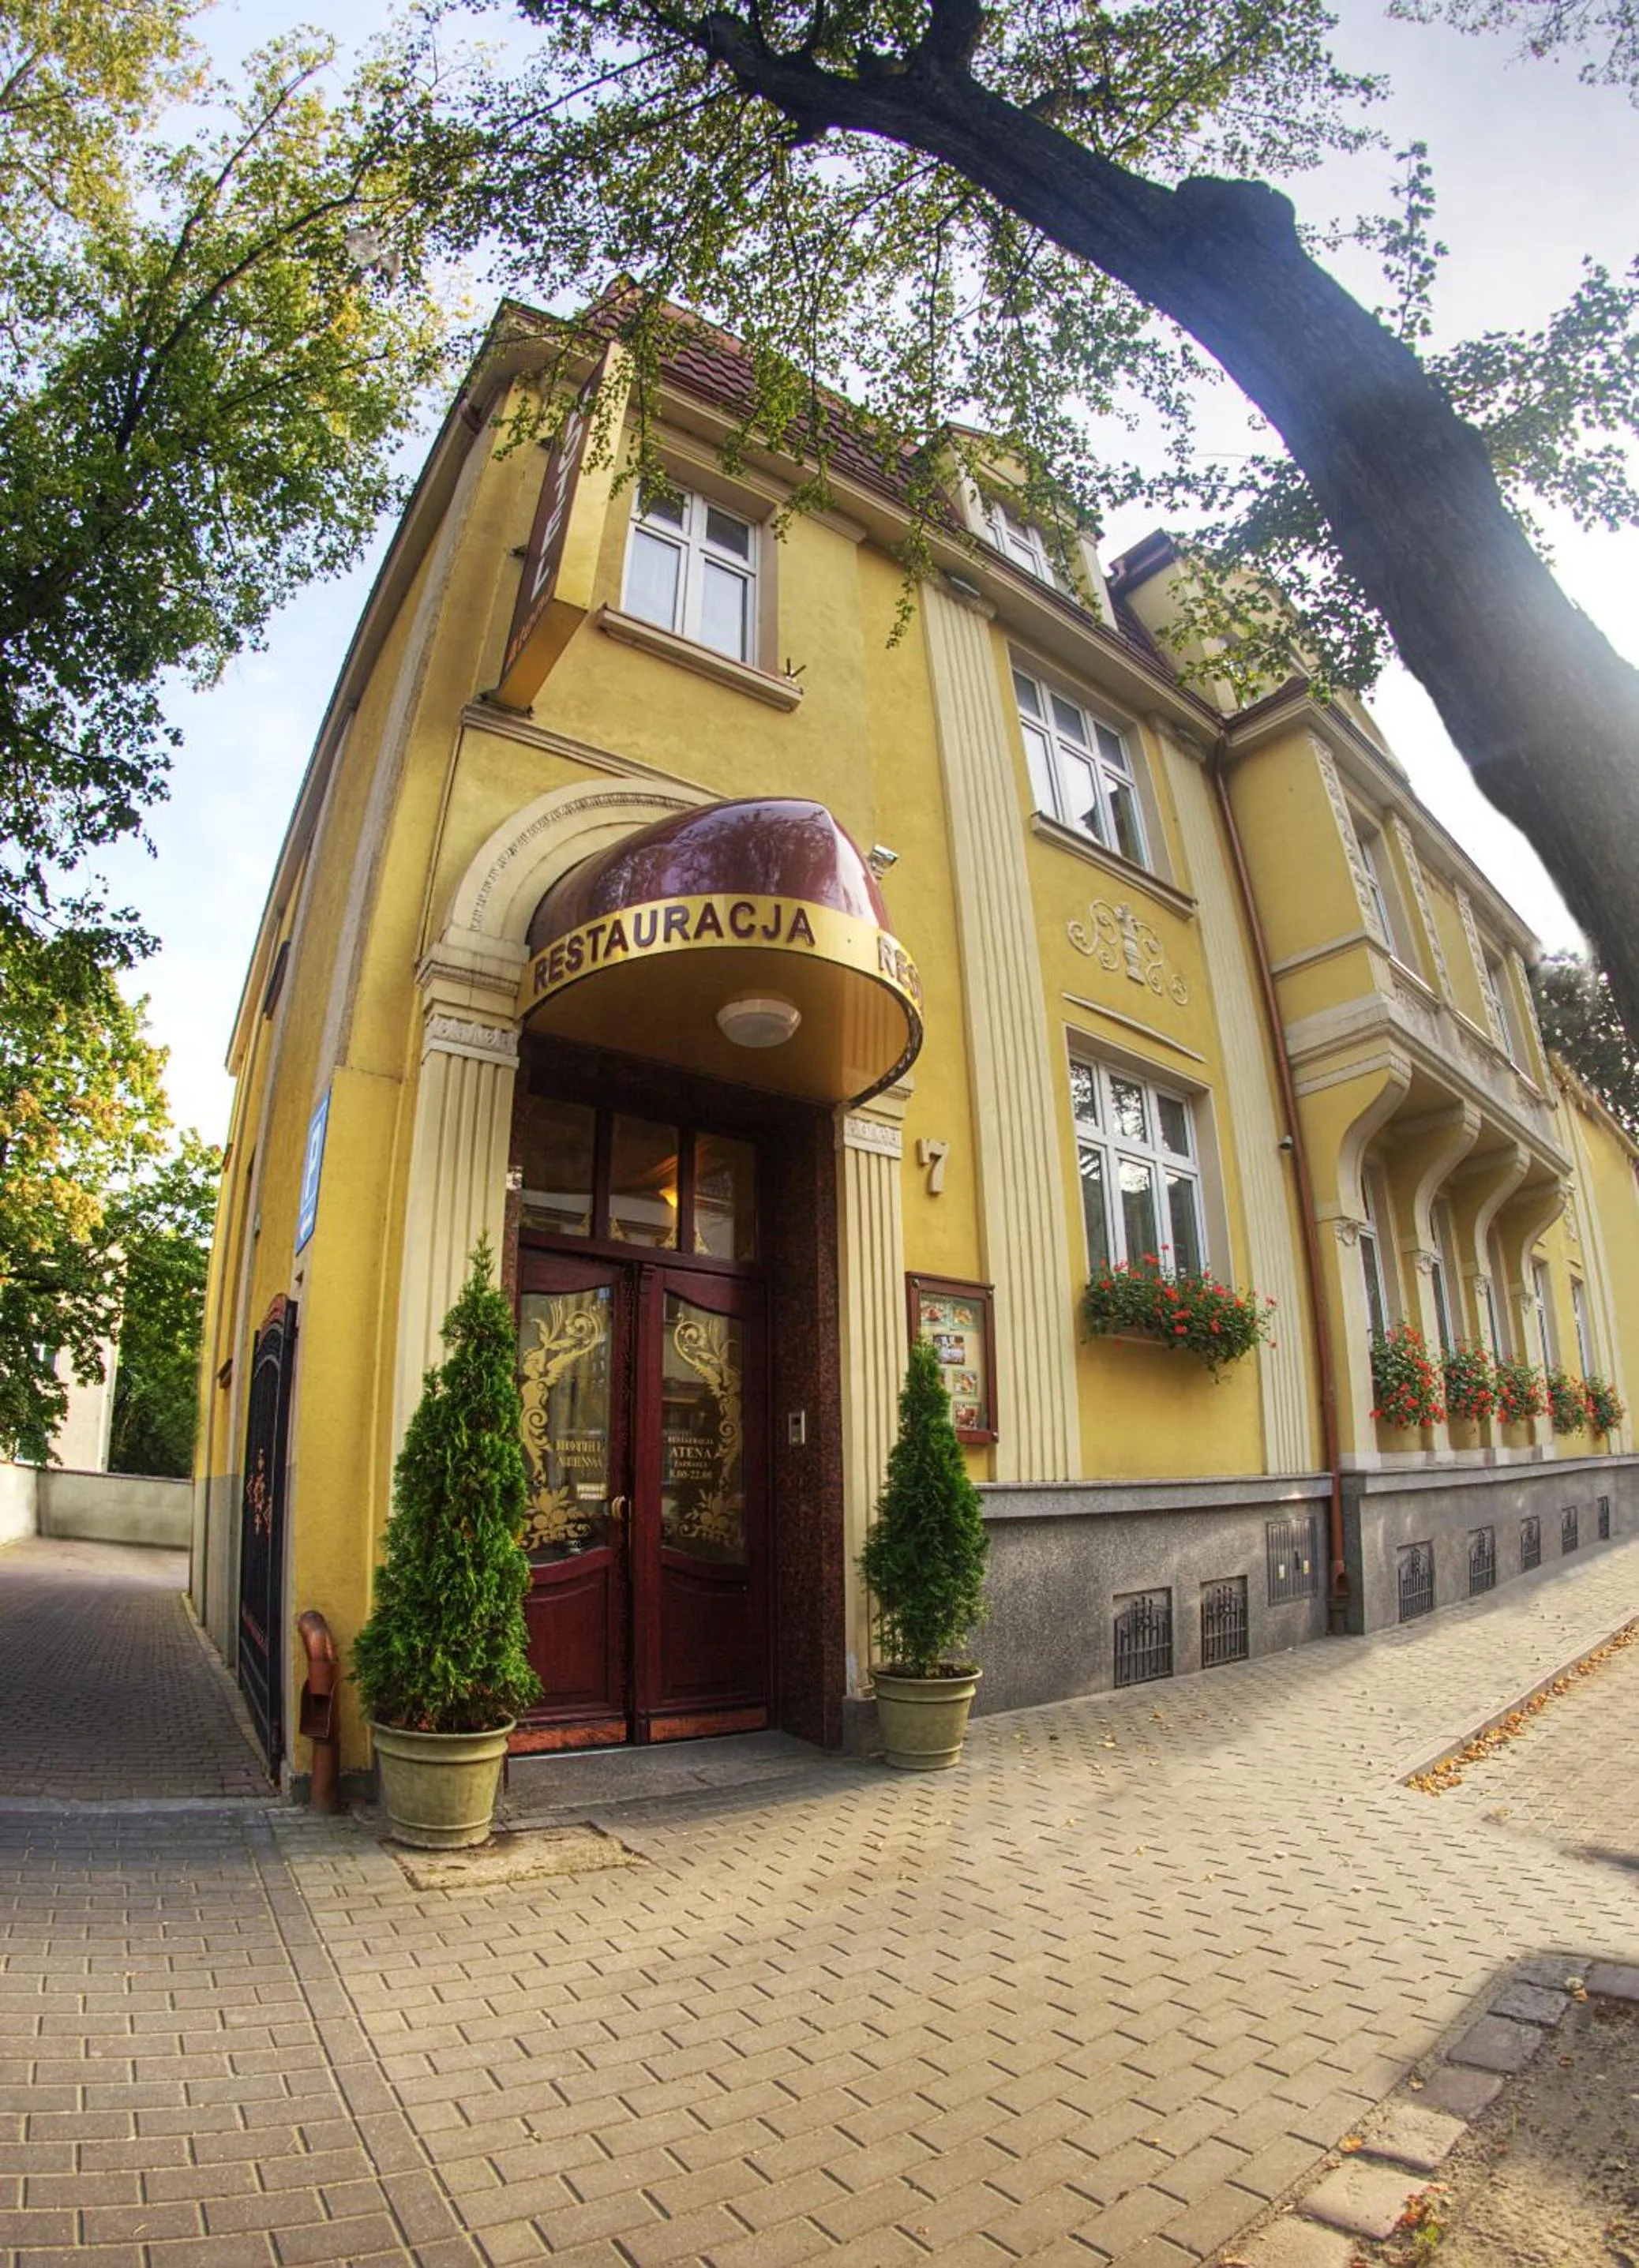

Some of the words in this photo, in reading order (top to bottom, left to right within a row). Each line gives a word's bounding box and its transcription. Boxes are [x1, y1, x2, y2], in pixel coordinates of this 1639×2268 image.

[532, 902, 816, 995] RESTAURACJA
[876, 935, 920, 1000] RES
[305, 1122, 322, 1200] P
[917, 1138, 949, 1195] 7
[669, 1445, 712, 1460] ATENA
